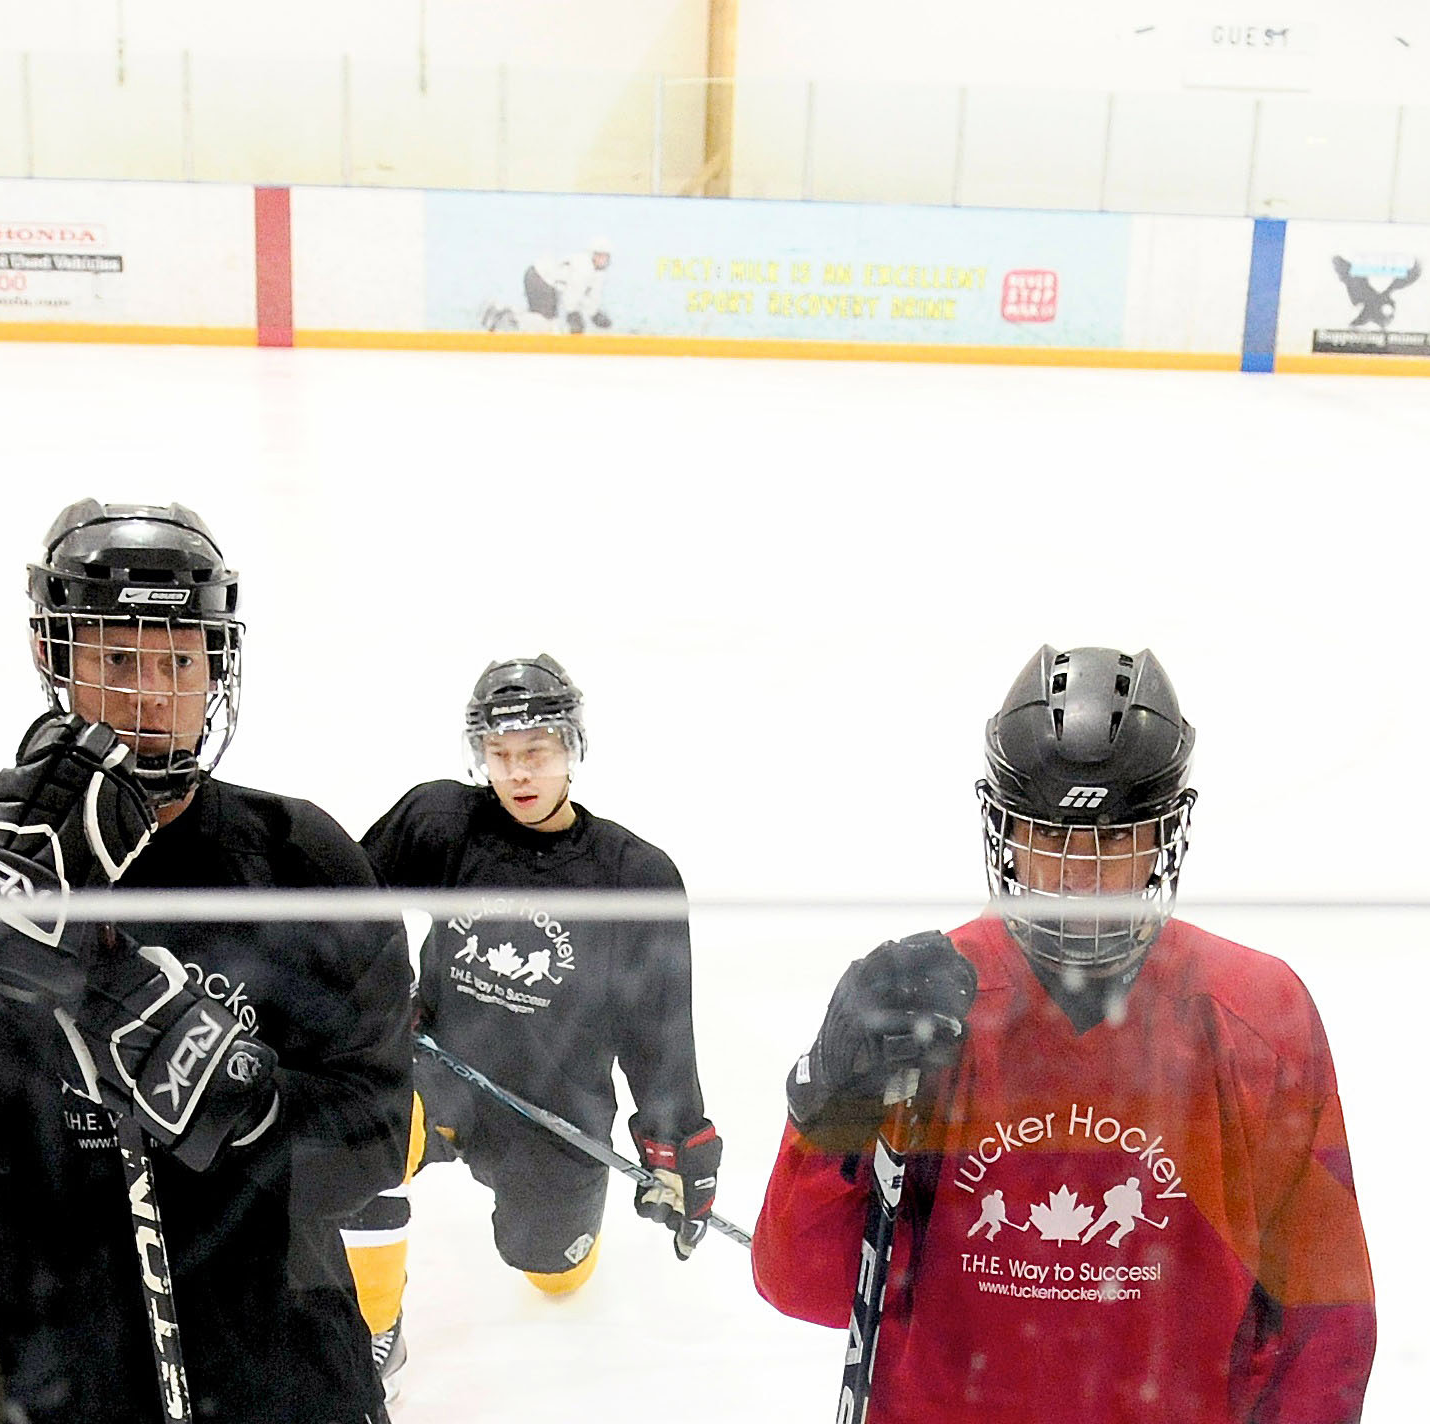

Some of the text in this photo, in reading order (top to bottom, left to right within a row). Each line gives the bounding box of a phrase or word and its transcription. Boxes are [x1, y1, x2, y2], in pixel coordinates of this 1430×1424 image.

[861, 262, 988, 289] EXCELLENT
[683, 289, 756, 315] SPORT
[767, 291, 880, 319] RECOVERY
[1069, 1103, 1187, 1200] Hockey
[961, 1253, 1161, 1284] T.H.E. Way to Success!
[978, 1281, 1141, 1303] www.tuckerhockey.com
